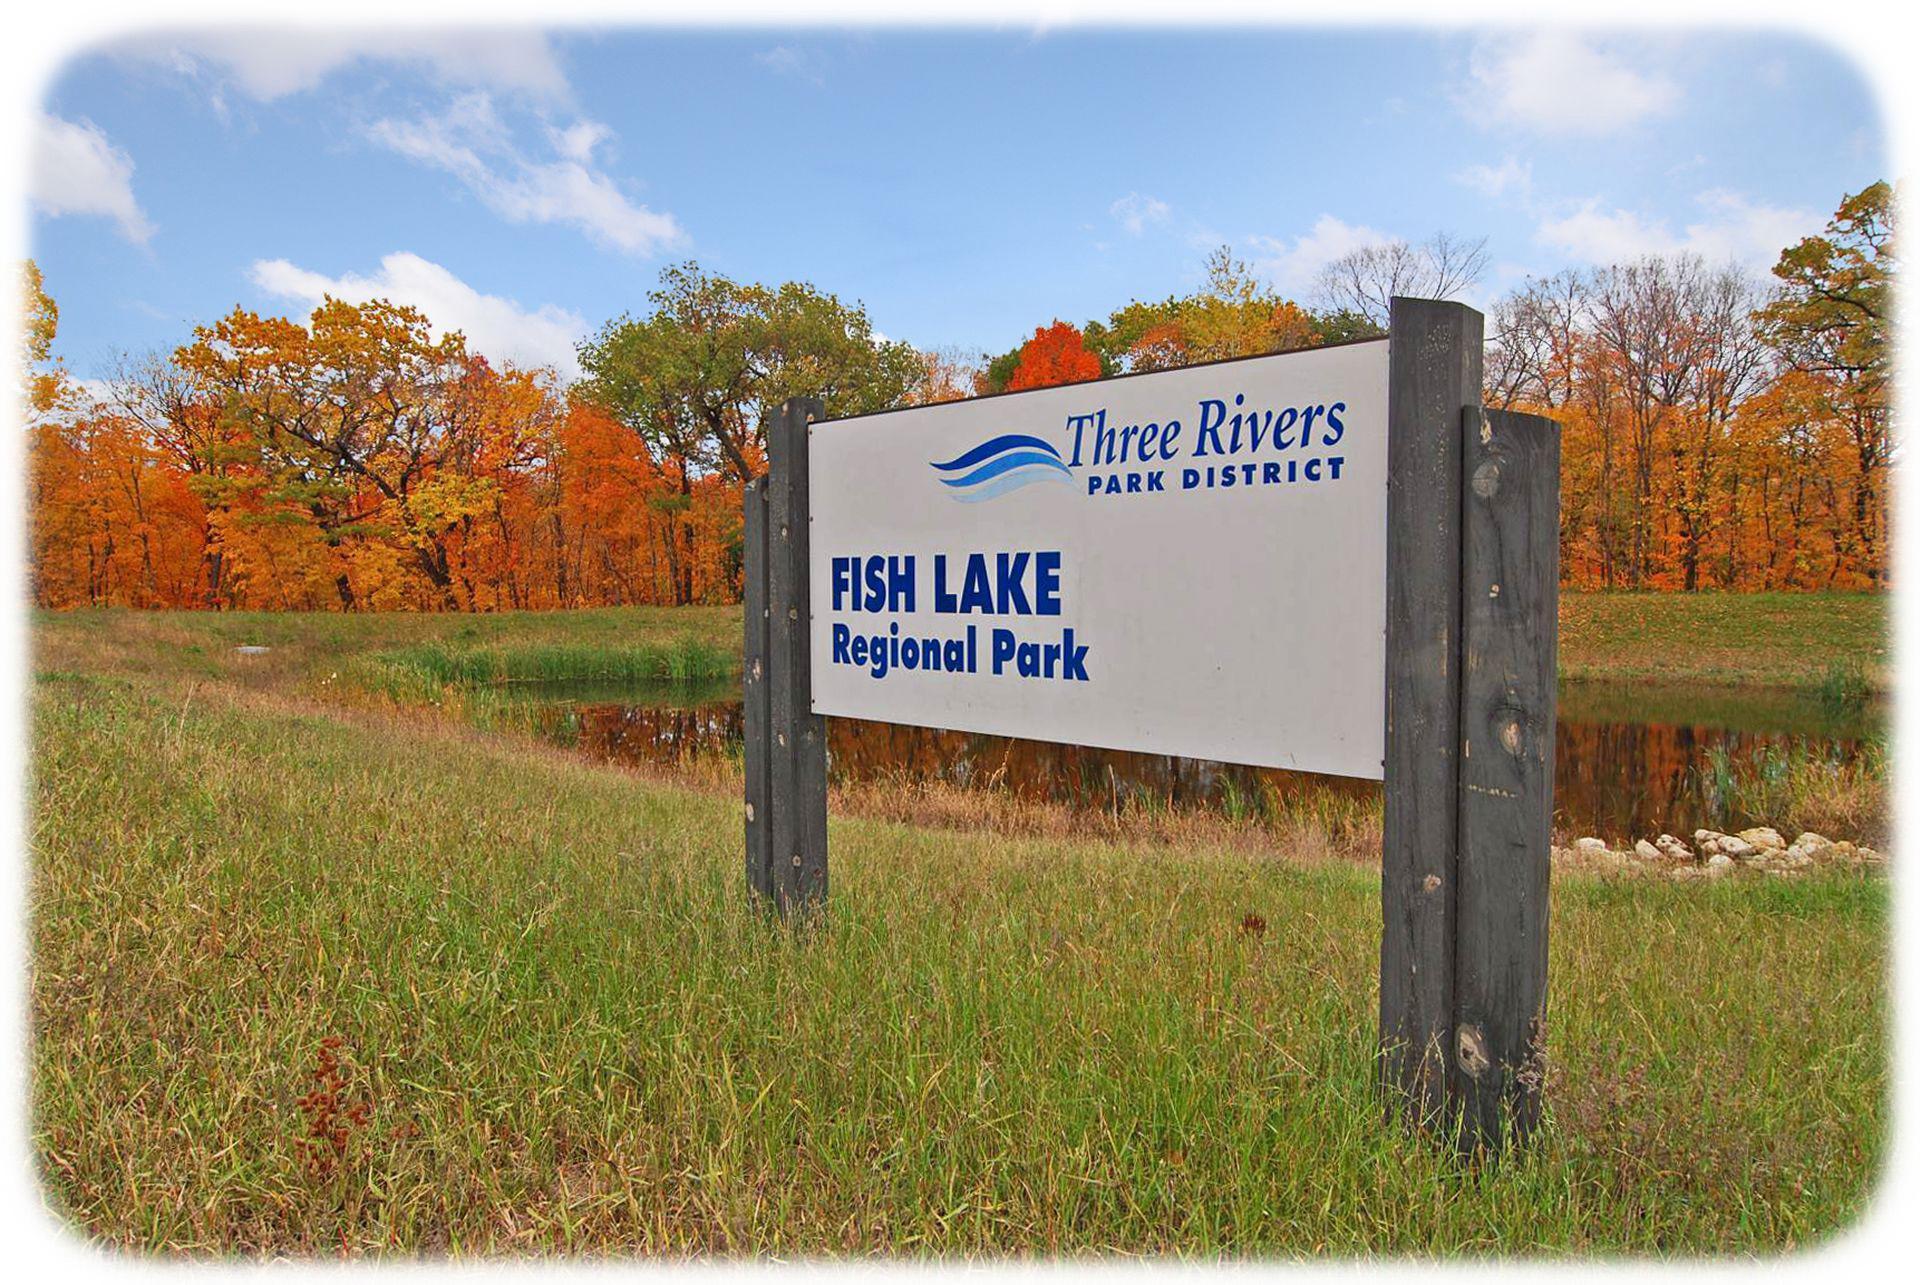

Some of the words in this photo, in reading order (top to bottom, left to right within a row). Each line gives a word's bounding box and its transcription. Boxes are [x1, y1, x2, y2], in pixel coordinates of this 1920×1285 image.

[1066, 408, 1181, 468] Three
[1193, 393, 1347, 458] Rivers
[1088, 469, 1164, 496] PARK
[1181, 456, 1345, 490] DISTRICT
[831, 554, 916, 613] FISH
[934, 550, 1062, 616] LAKE
[832, 621, 977, 679] Regional
[991, 627, 1090, 682] Park
